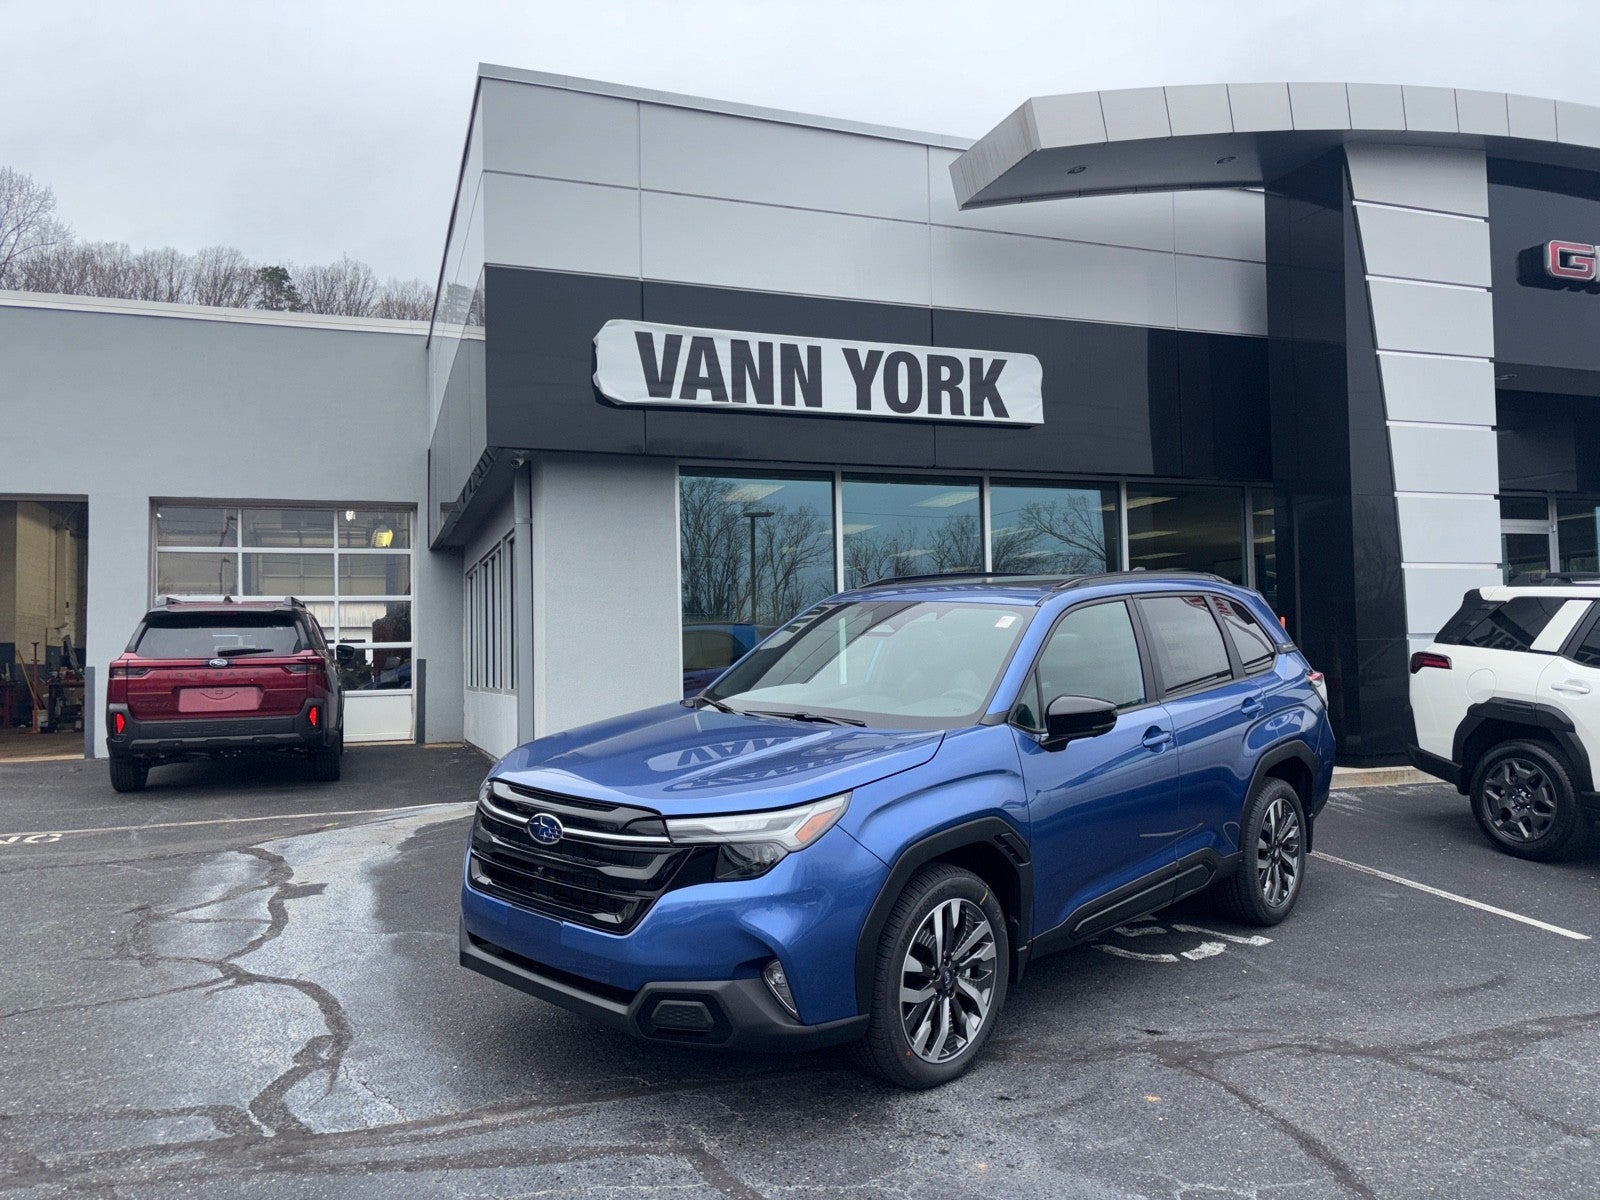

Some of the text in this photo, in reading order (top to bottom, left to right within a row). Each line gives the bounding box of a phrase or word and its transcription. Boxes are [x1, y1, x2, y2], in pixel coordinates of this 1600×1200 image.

[1546, 240, 1600, 281] G
[634, 331, 1010, 419] VANN YORK
